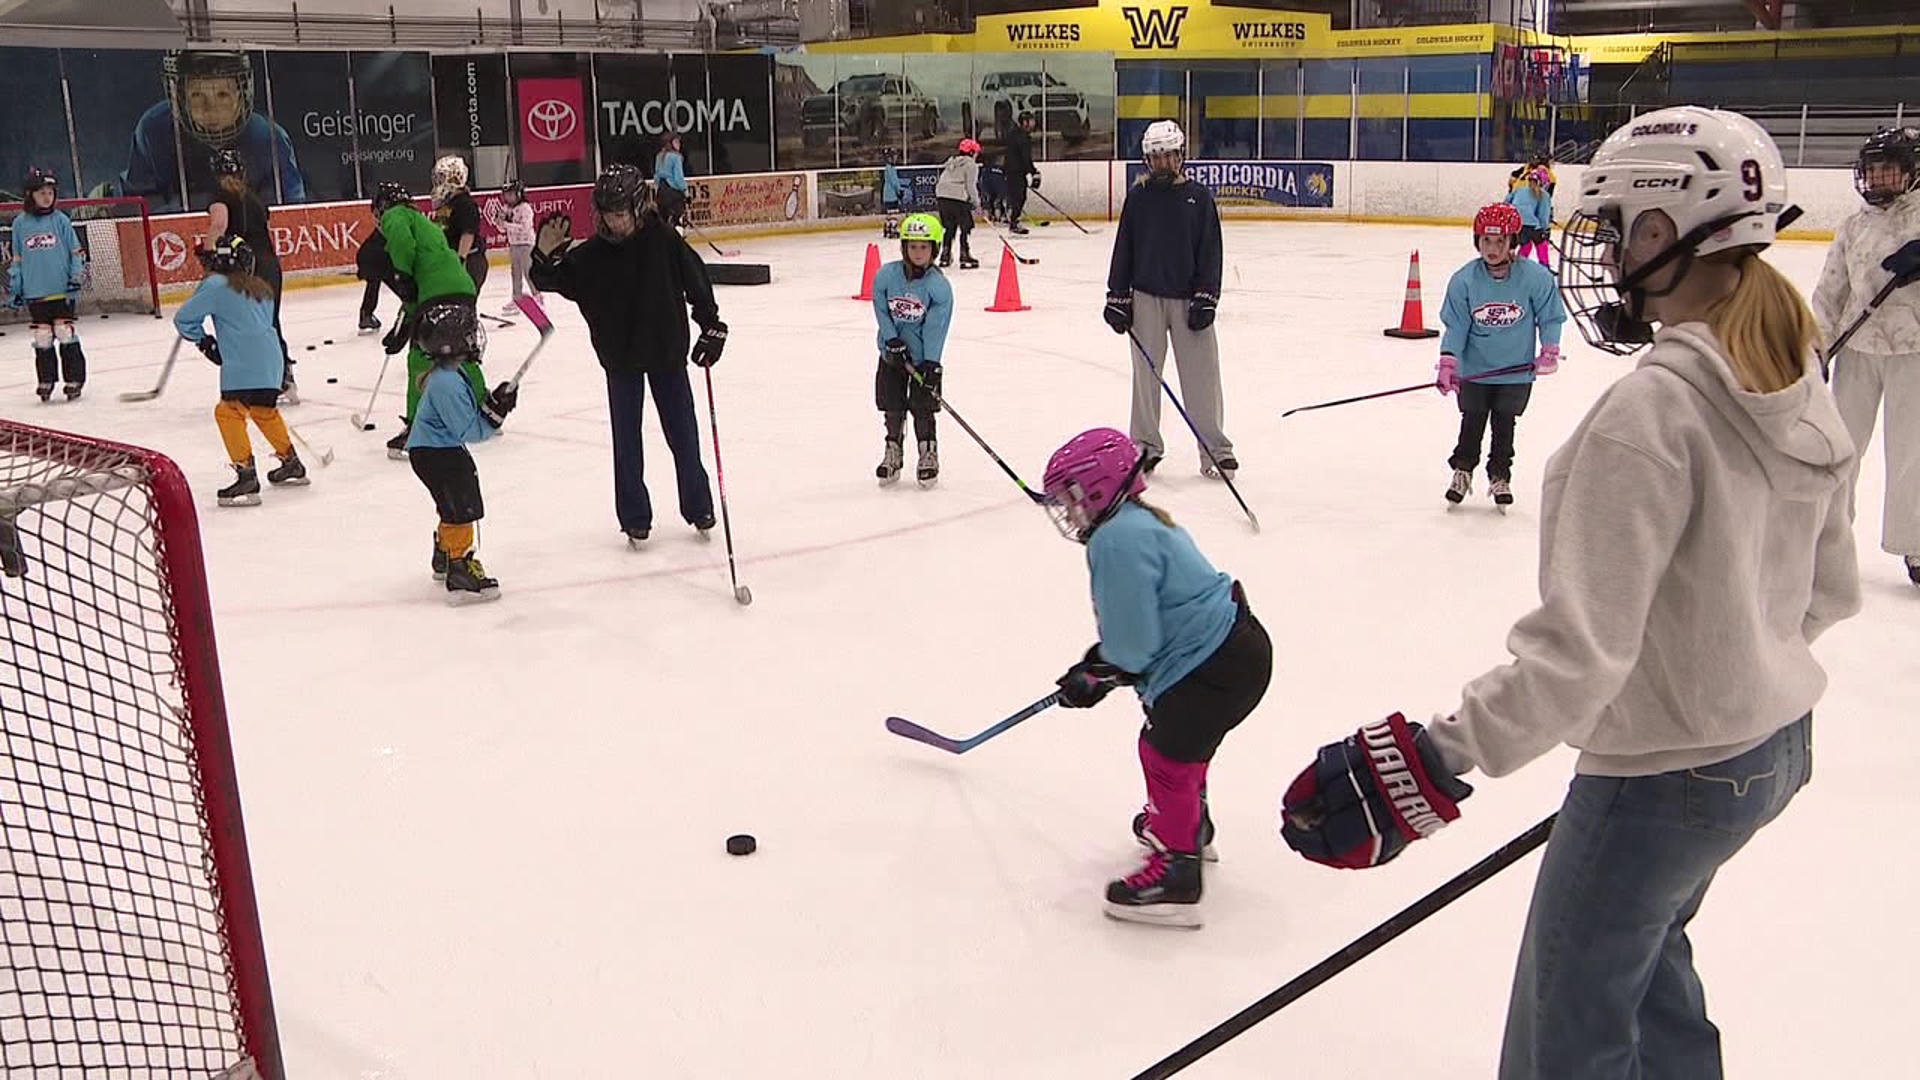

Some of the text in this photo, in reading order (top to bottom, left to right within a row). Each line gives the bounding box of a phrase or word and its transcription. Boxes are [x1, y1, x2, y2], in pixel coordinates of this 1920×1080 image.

[1006, 23, 1081, 42] WILKES
[1122, 7, 1188, 49] W
[1232, 22, 1306, 41] WILKES
[467, 62, 482, 147] toyota.com
[601, 98, 751, 136] TACOMA
[303, 109, 415, 142] Geisinger
[1184, 163, 1298, 196] SERICORDIA
[1216, 185, 1267, 198] HOCKEY
[1633, 177, 1680, 189] CCM
[1740, 158, 1763, 202] 9
[271, 220, 361, 256] BANK
